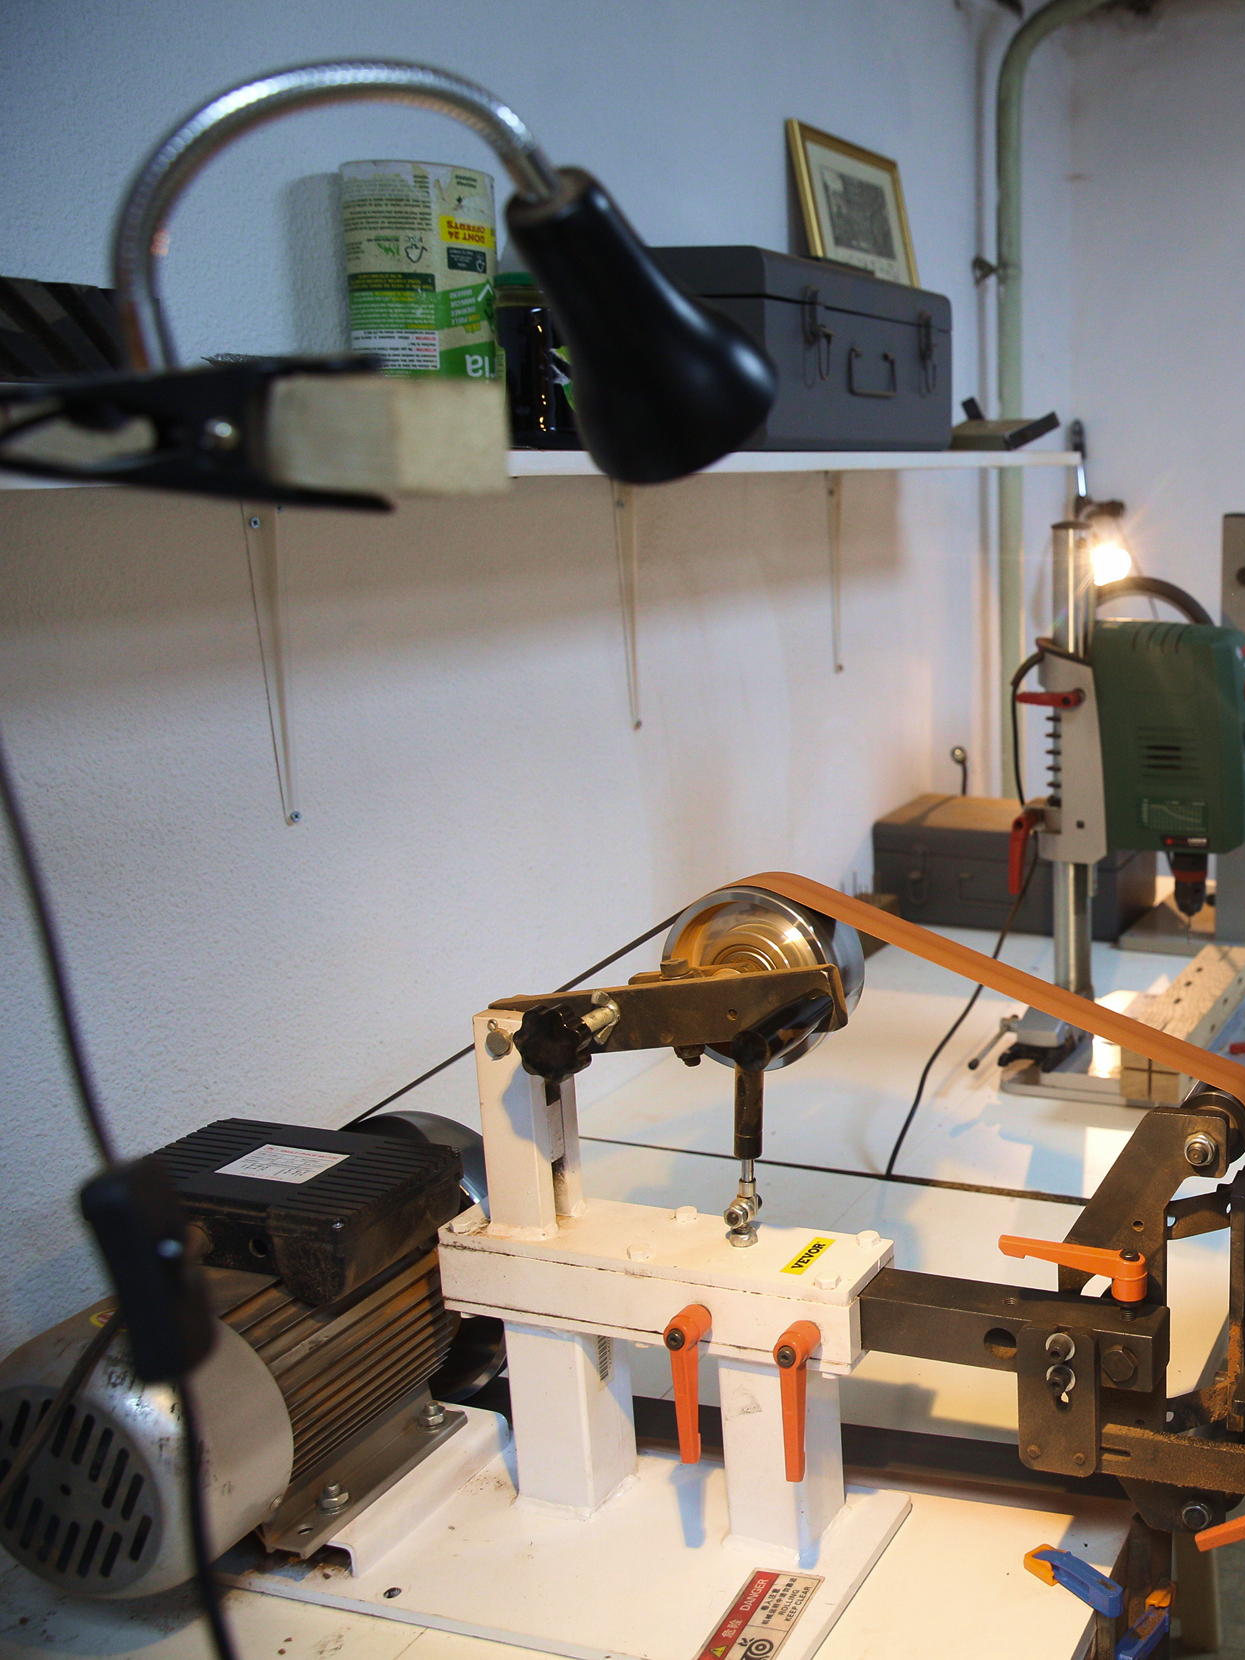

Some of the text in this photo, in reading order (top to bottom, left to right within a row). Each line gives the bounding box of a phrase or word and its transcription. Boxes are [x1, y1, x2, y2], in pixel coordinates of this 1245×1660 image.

[448, 230, 486, 244] DONT 24
[790, 1243, 826, 1269] VEVOR
[721, 1579, 769, 1638] 危险 DANGER
[778, 1590, 800, 1616] ROLLING
[784, 1586, 812, 1622] KEEP CLEAR
